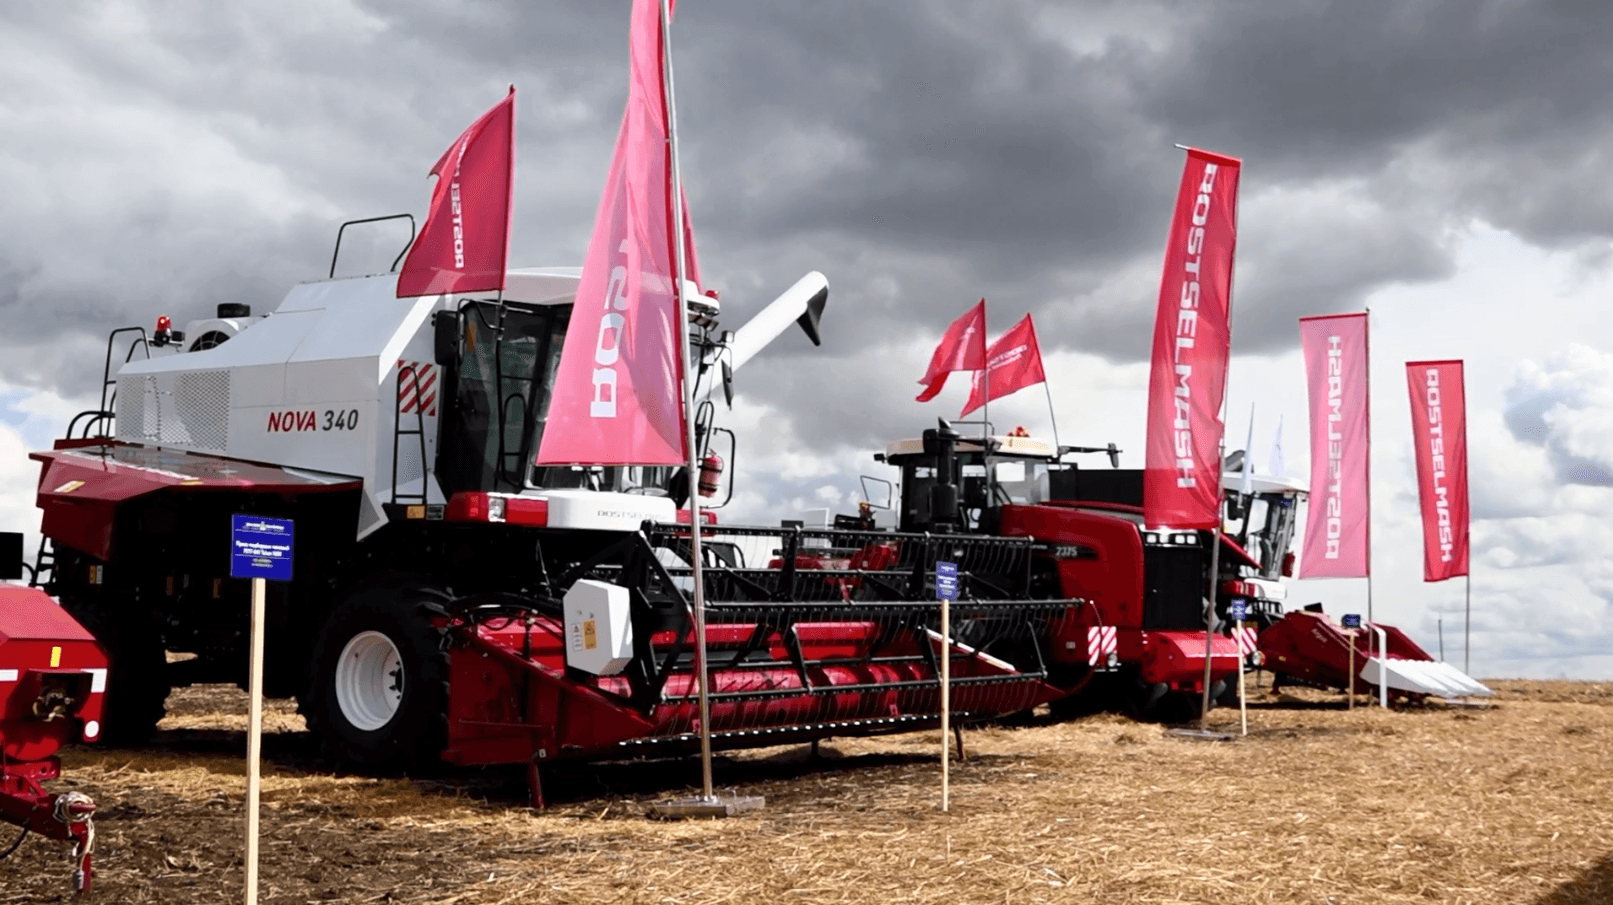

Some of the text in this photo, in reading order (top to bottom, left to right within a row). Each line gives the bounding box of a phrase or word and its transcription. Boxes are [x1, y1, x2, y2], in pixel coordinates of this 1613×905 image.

[1174, 162, 1218, 490] ROSTSELMASH
[267, 408, 359, 433] NOVA 340
[1425, 368, 1454, 563] ROSTSELMASH
[597, 510, 668, 520] ROSTSELM
[1055, 545, 1078, 557] 2375
